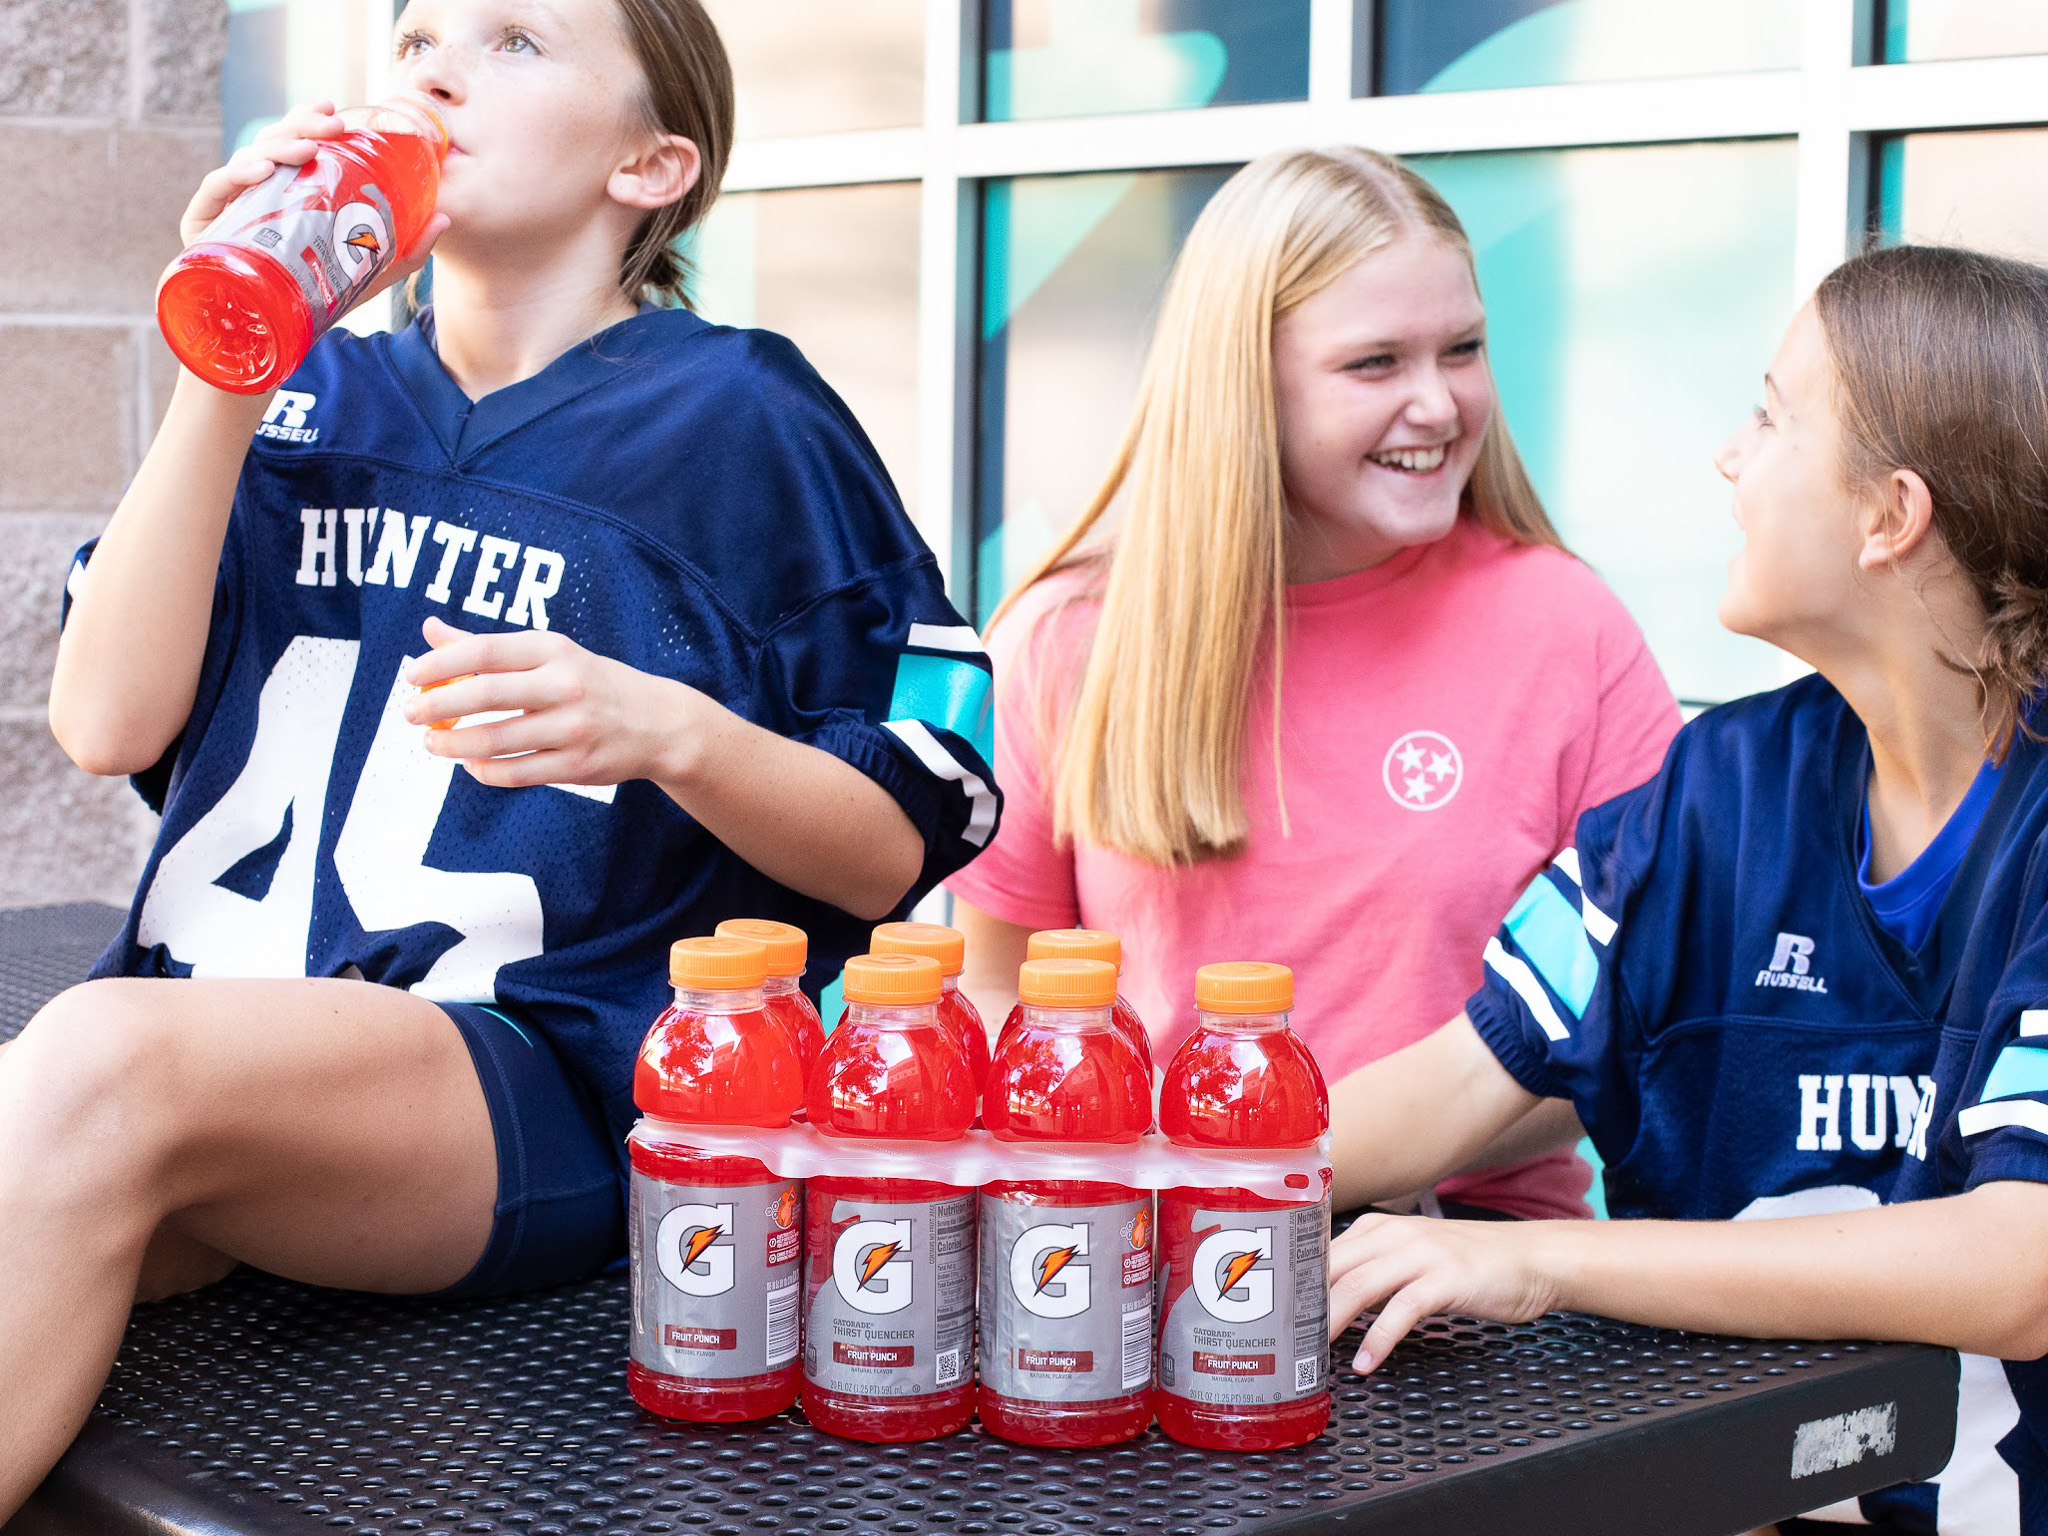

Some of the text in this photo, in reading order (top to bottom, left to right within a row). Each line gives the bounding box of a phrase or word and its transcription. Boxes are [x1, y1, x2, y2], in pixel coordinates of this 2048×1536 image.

[262, 389, 317, 428] R
[295, 507, 566, 631] HUNTER
[137, 635, 618, 1004] 45
[1768, 932, 1815, 975] R
[1755, 970, 1828, 994] RUSSELL
[656, 1203, 735, 1297] G
[833, 1218, 913, 1315] G
[1010, 1222, 1091, 1319] G
[1192, 1226, 1274, 1323] G
[671, 1331, 720, 1344] FRUIT PUNCH
[833, 1326, 915, 1340] THIRST QUENCHER
[1193, 1335, 1276, 1349] THIRST QUENCHER
[847, 1350, 898, 1361] FRUIT PUNCH
[1025, 1355, 1077, 1366] FRUIT PUNCH
[1208, 1359, 1259, 1370] FRUIT PUNCH
[837, 1381, 844, 1390] FL
[881, 1386, 892, 1395] 591
[1197, 1390, 1204, 1400] FL
[1242, 1394, 1254, 1403] 591
[1255, 1394, 1265, 1402] mL
